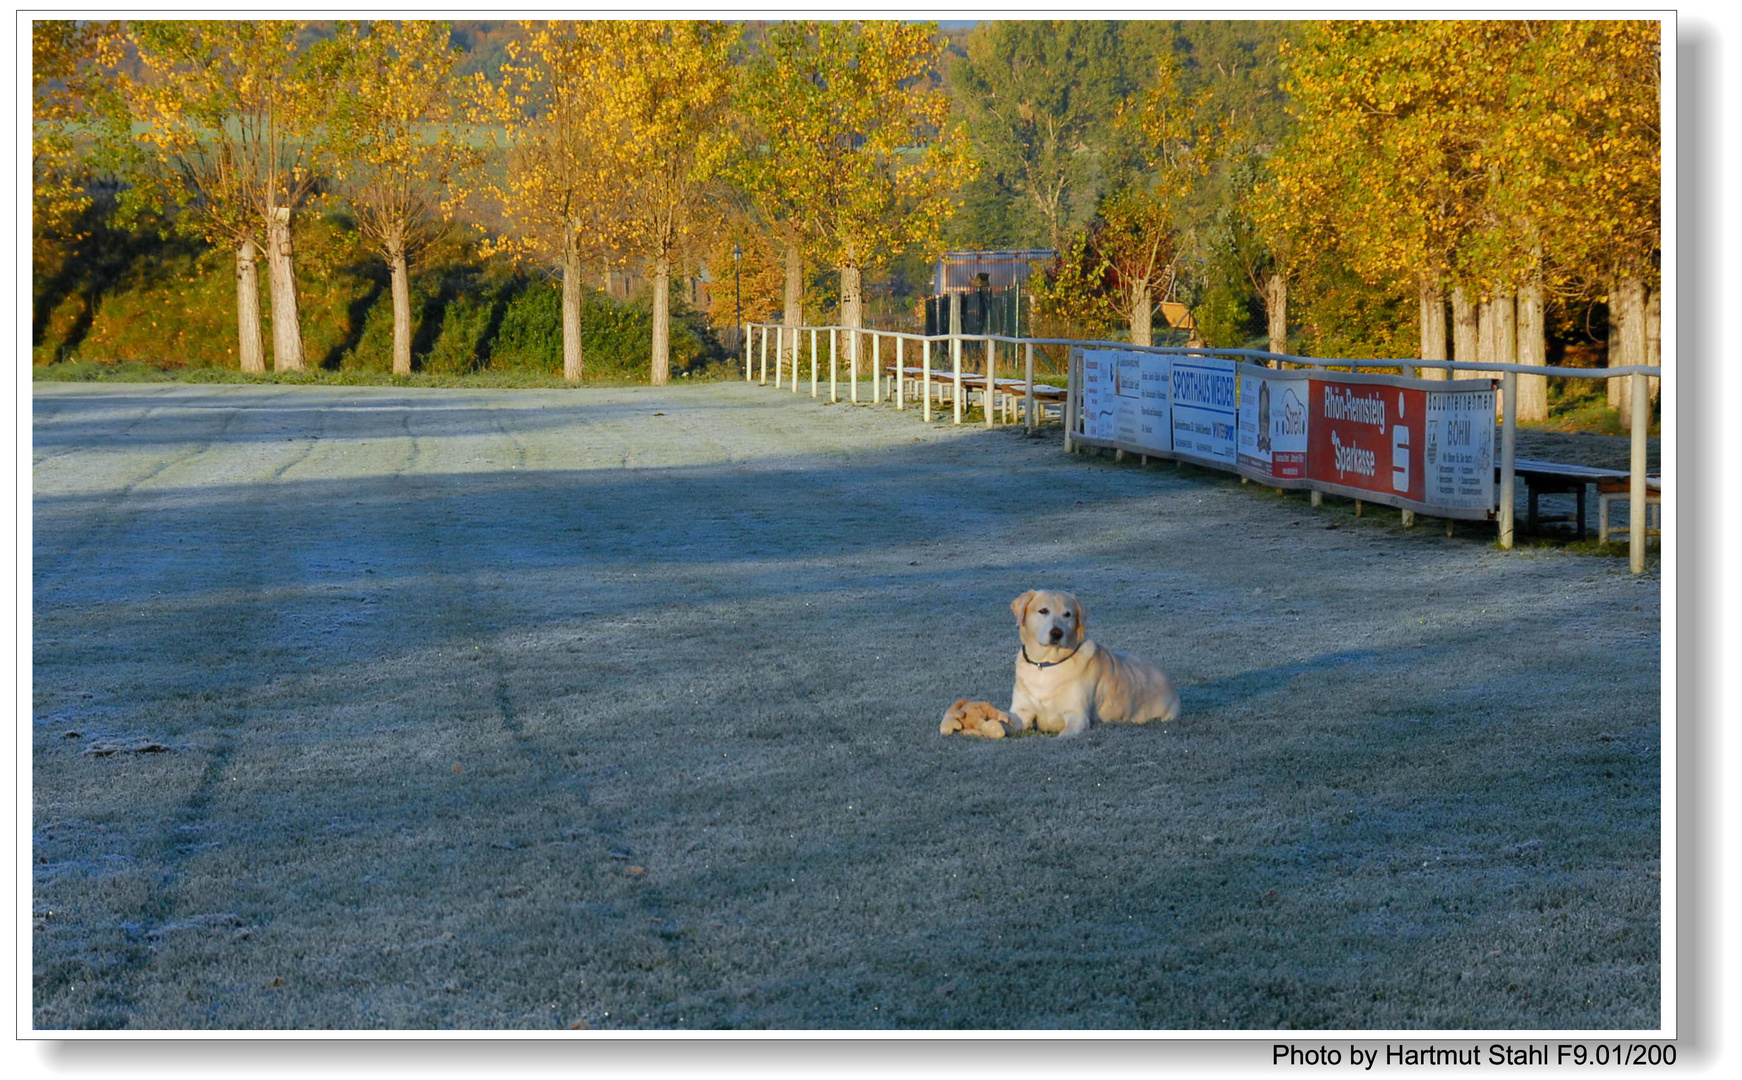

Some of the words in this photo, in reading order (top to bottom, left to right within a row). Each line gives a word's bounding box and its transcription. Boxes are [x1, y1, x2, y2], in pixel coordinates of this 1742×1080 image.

[1173, 370, 1210, 404] SPORTHAUS
[1325, 386, 1385, 435] Rhön-Rennsteig
[1332, 430, 1375, 480] Sparkasse
